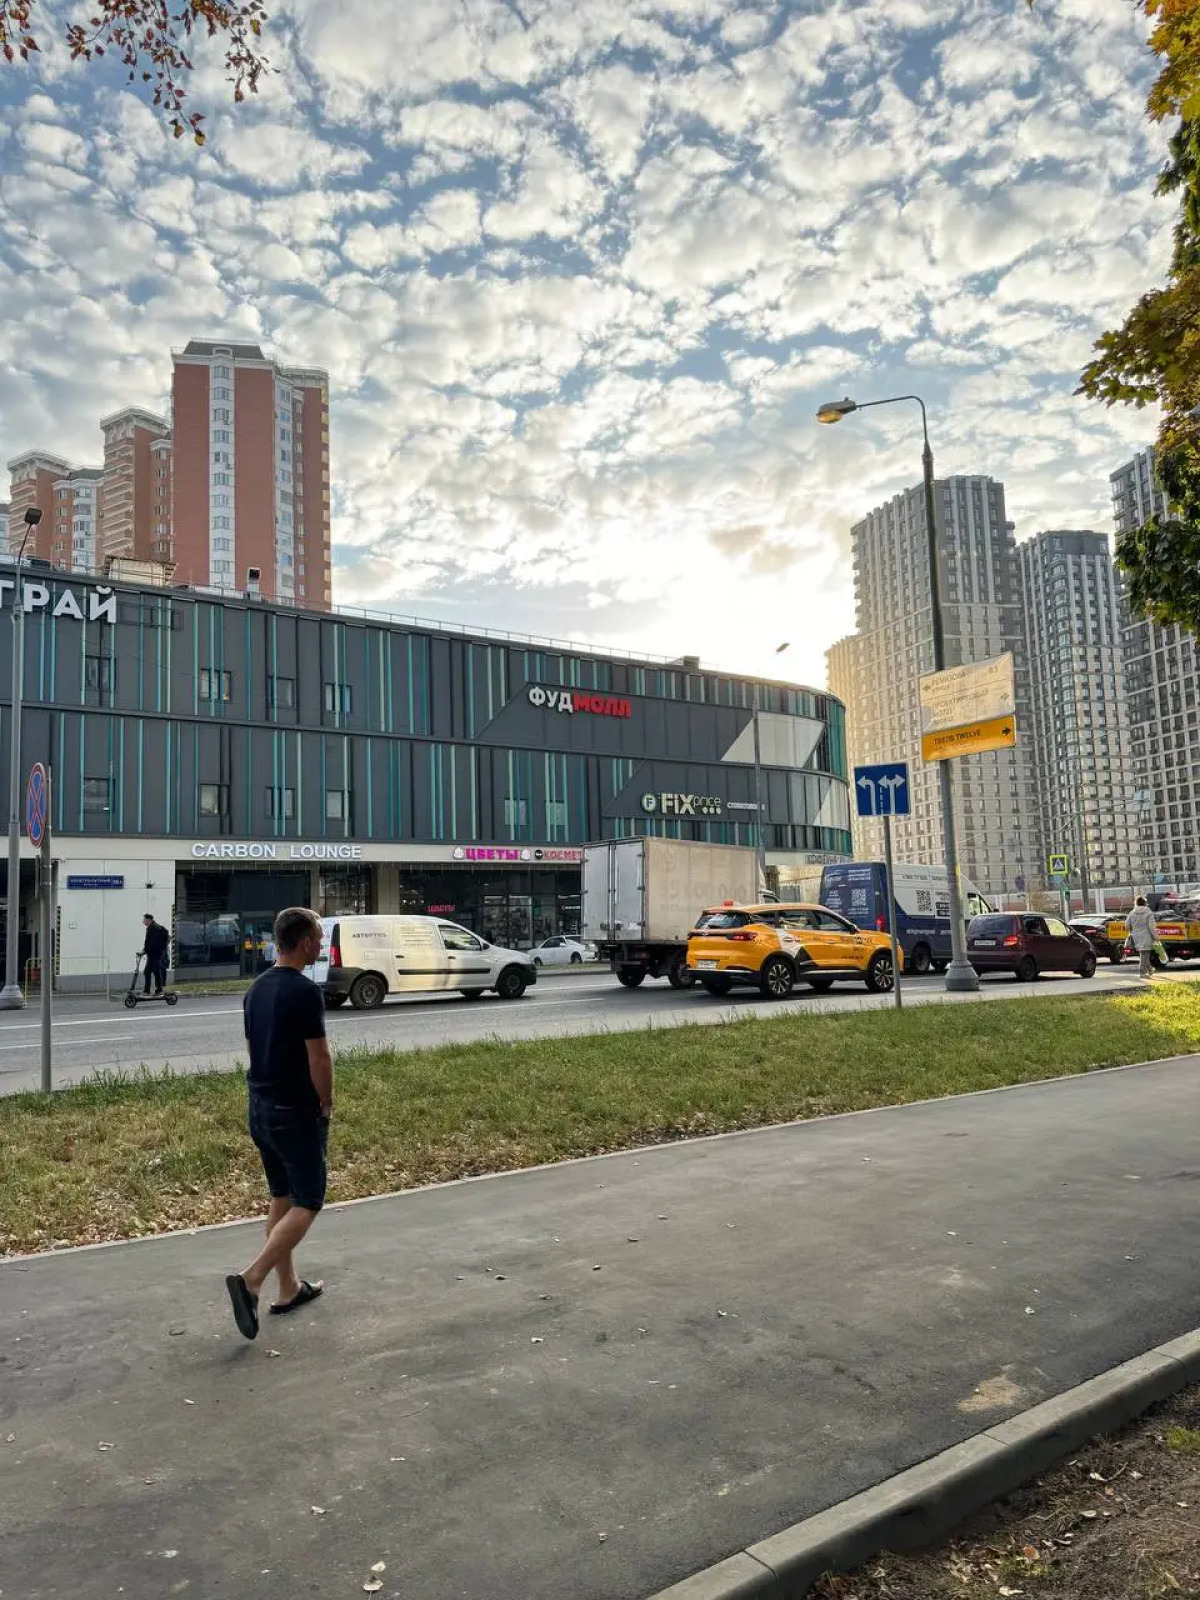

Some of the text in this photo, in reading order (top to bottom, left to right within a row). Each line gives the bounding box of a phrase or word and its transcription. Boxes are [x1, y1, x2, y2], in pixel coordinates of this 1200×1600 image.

[191, 843, 362, 859] CARBON LOUNGE
[465, 847, 519, 861] ЦВЕТЫ
